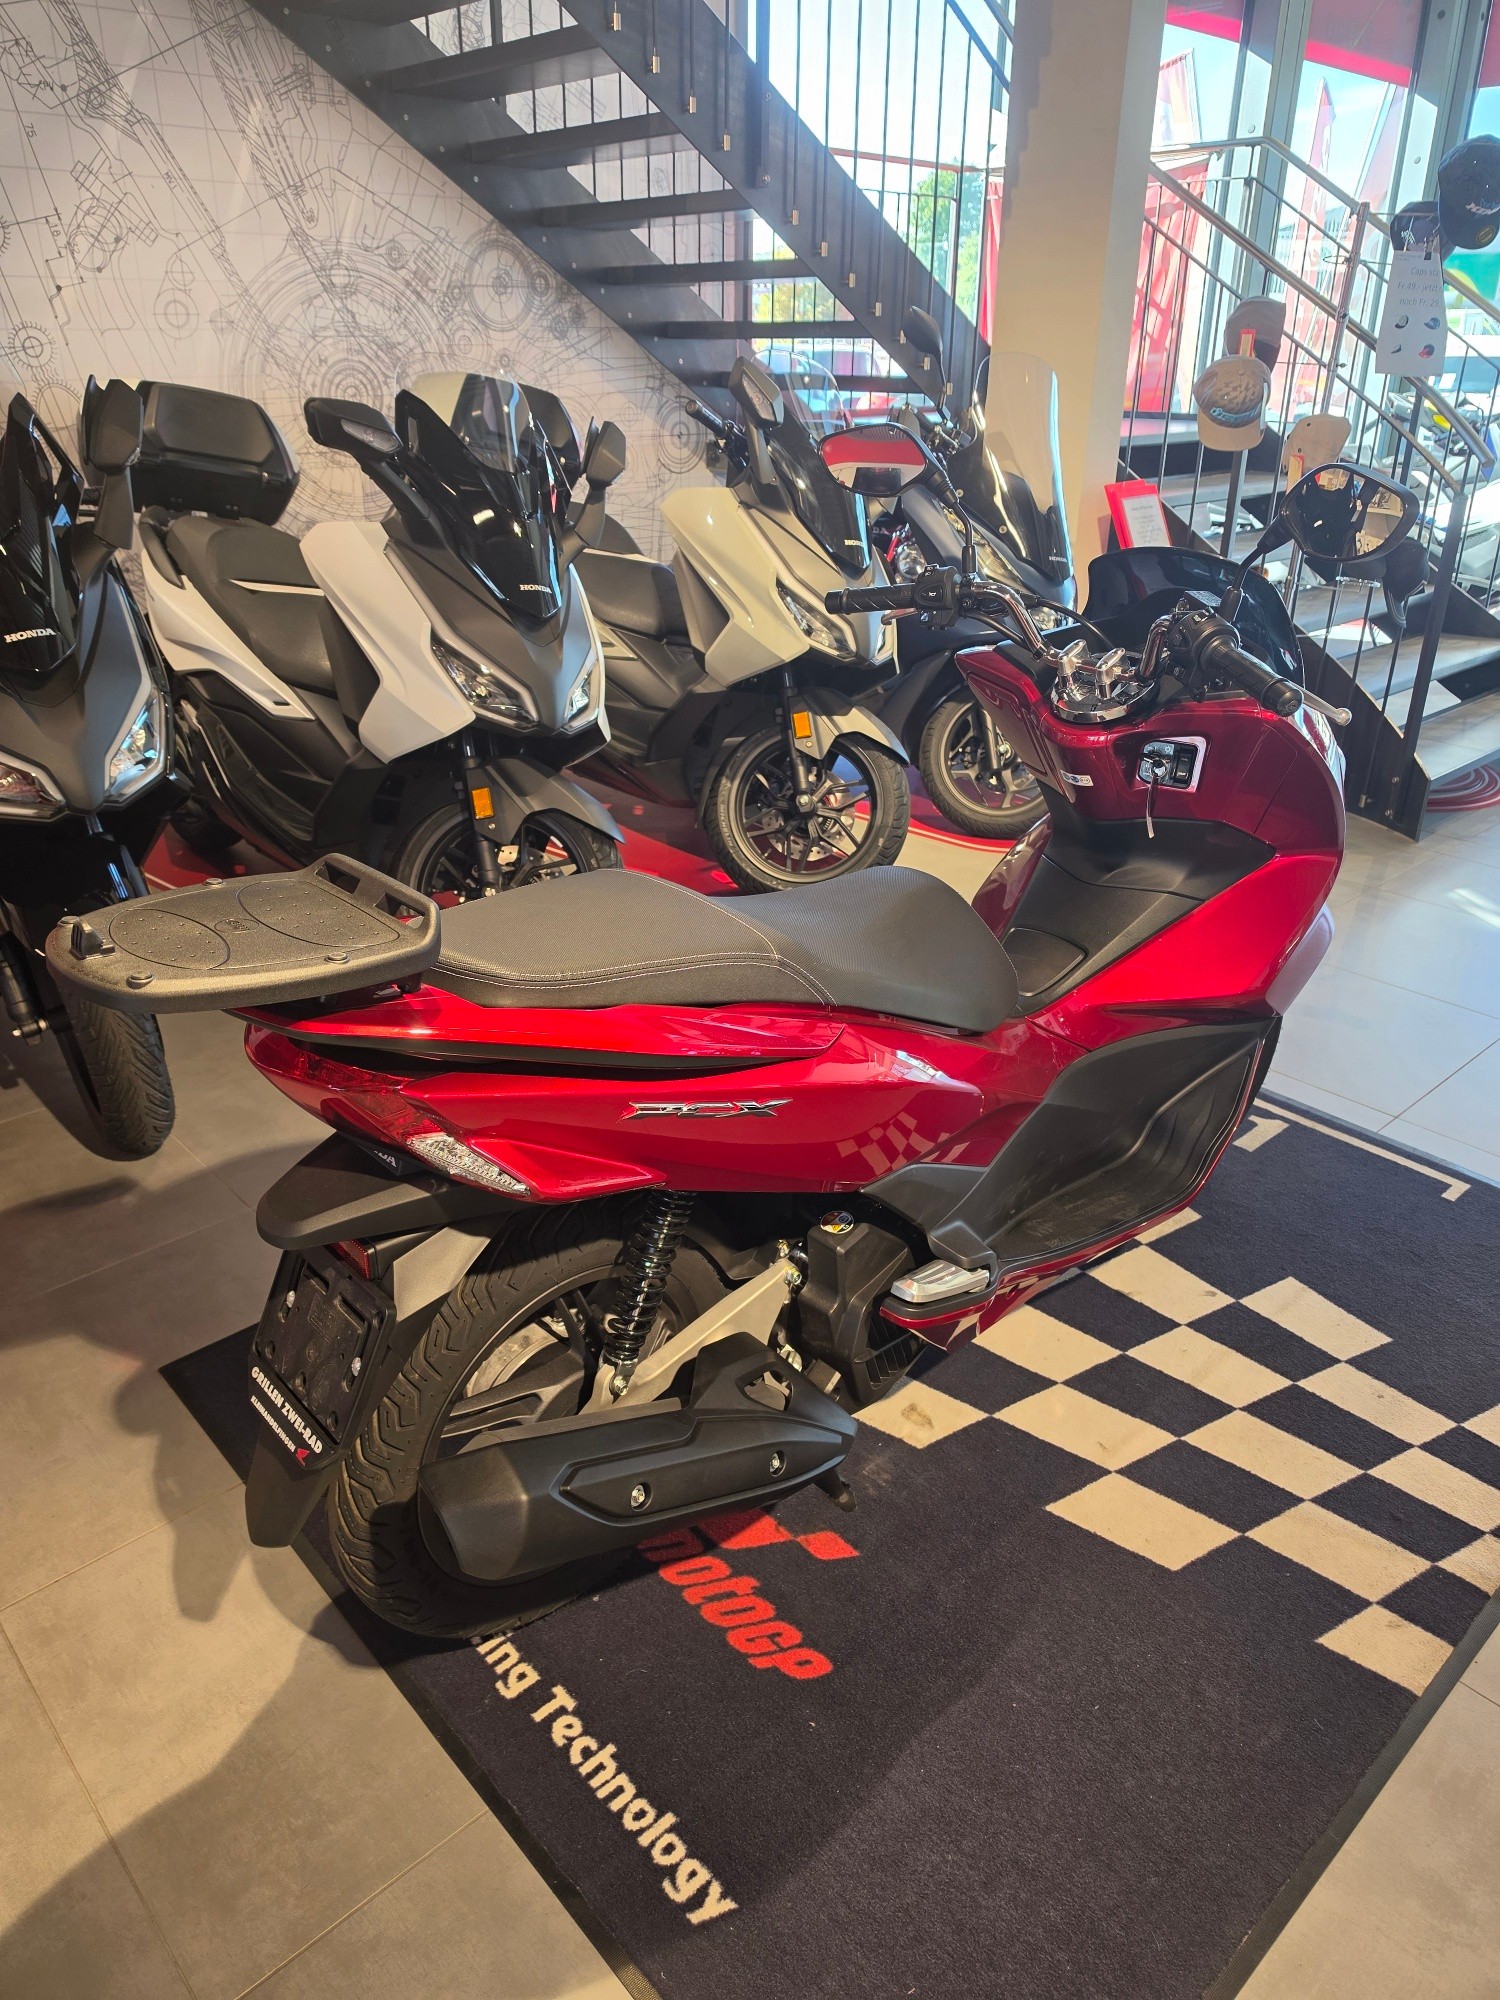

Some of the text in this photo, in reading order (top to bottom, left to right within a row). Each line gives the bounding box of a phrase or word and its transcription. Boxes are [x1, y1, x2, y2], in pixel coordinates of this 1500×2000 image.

[1410, 266, 1429, 277] Caps
[1399, 297, 1418, 307] noch
[519, 584, 553, 594] HONDA
[3, 627, 57, 643] HONDA
[251, 1366, 323, 1454] GRILLEN ZWEI-RAD
[471, 1632, 738, 1926] ing Technology
